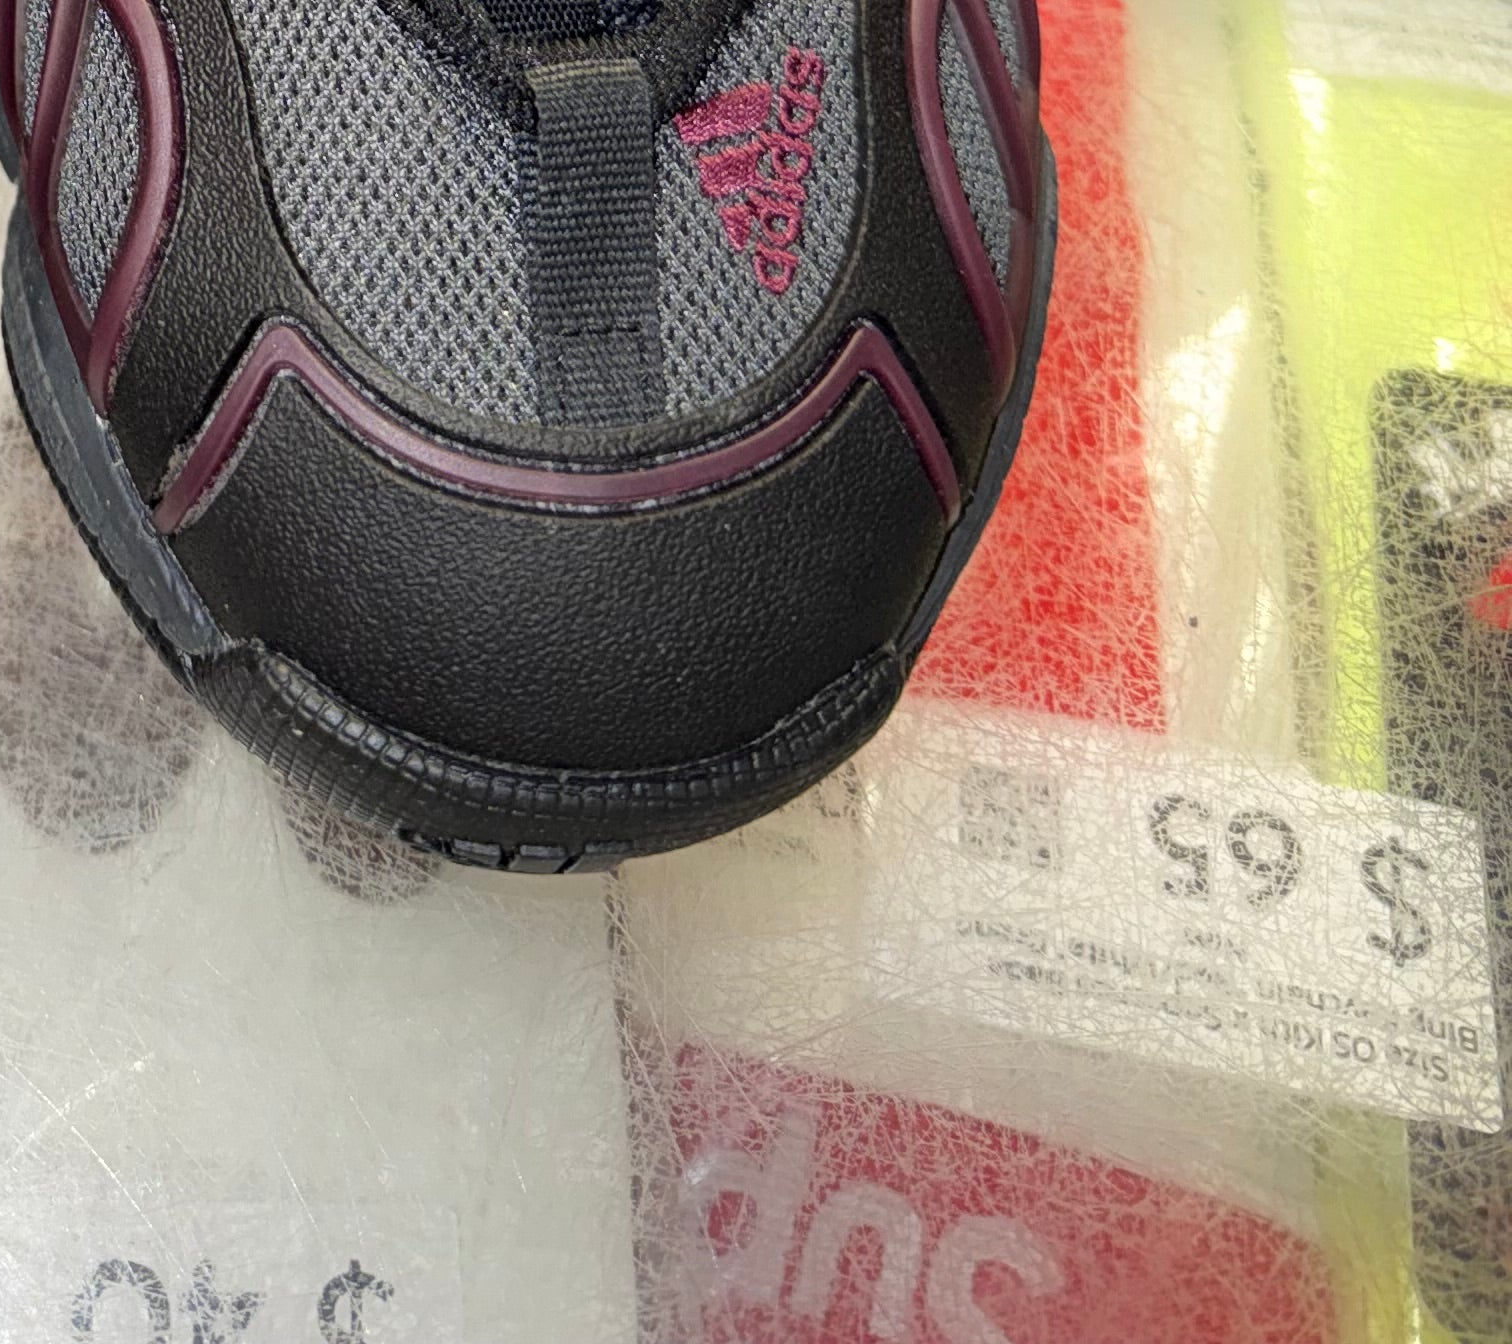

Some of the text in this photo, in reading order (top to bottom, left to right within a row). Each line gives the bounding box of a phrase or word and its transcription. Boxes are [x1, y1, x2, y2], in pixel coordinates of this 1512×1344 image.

[753, 44, 825, 296] adidas
[1149, 793, 1303, 908] 65
[1360, 835, 1433, 968] $
